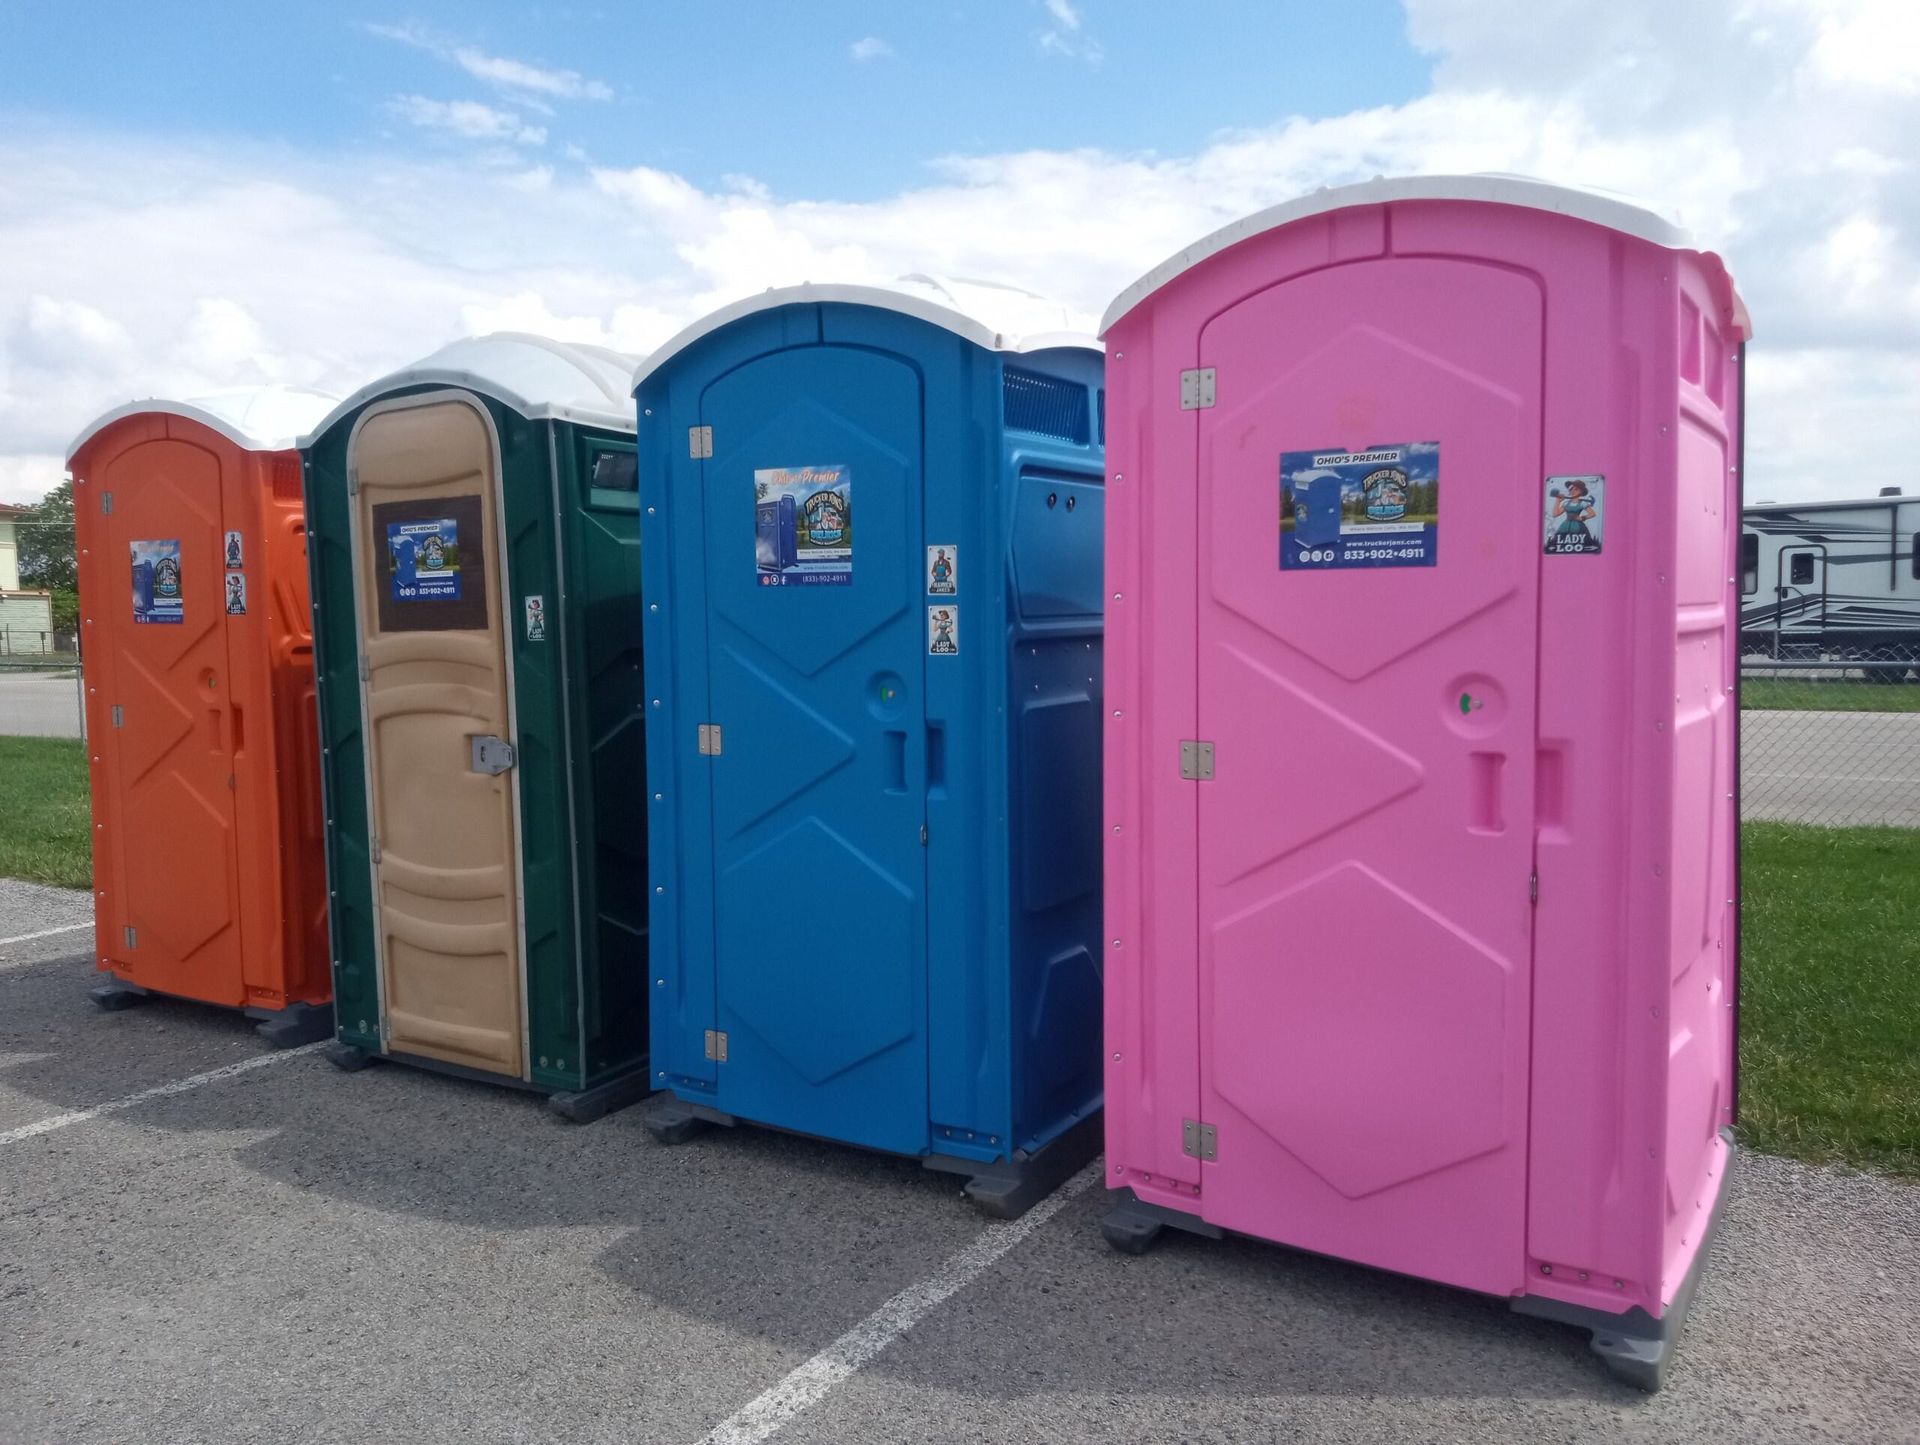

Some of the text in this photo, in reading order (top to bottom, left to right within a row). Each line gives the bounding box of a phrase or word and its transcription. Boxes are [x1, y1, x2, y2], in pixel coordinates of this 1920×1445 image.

[1316, 452, 1398, 466] OHIO'S PREMIER
[1362, 469, 1390, 491] TRUCKER
[1557, 534, 1586, 544] LADY
[1556, 544, 1584, 552] LOO
